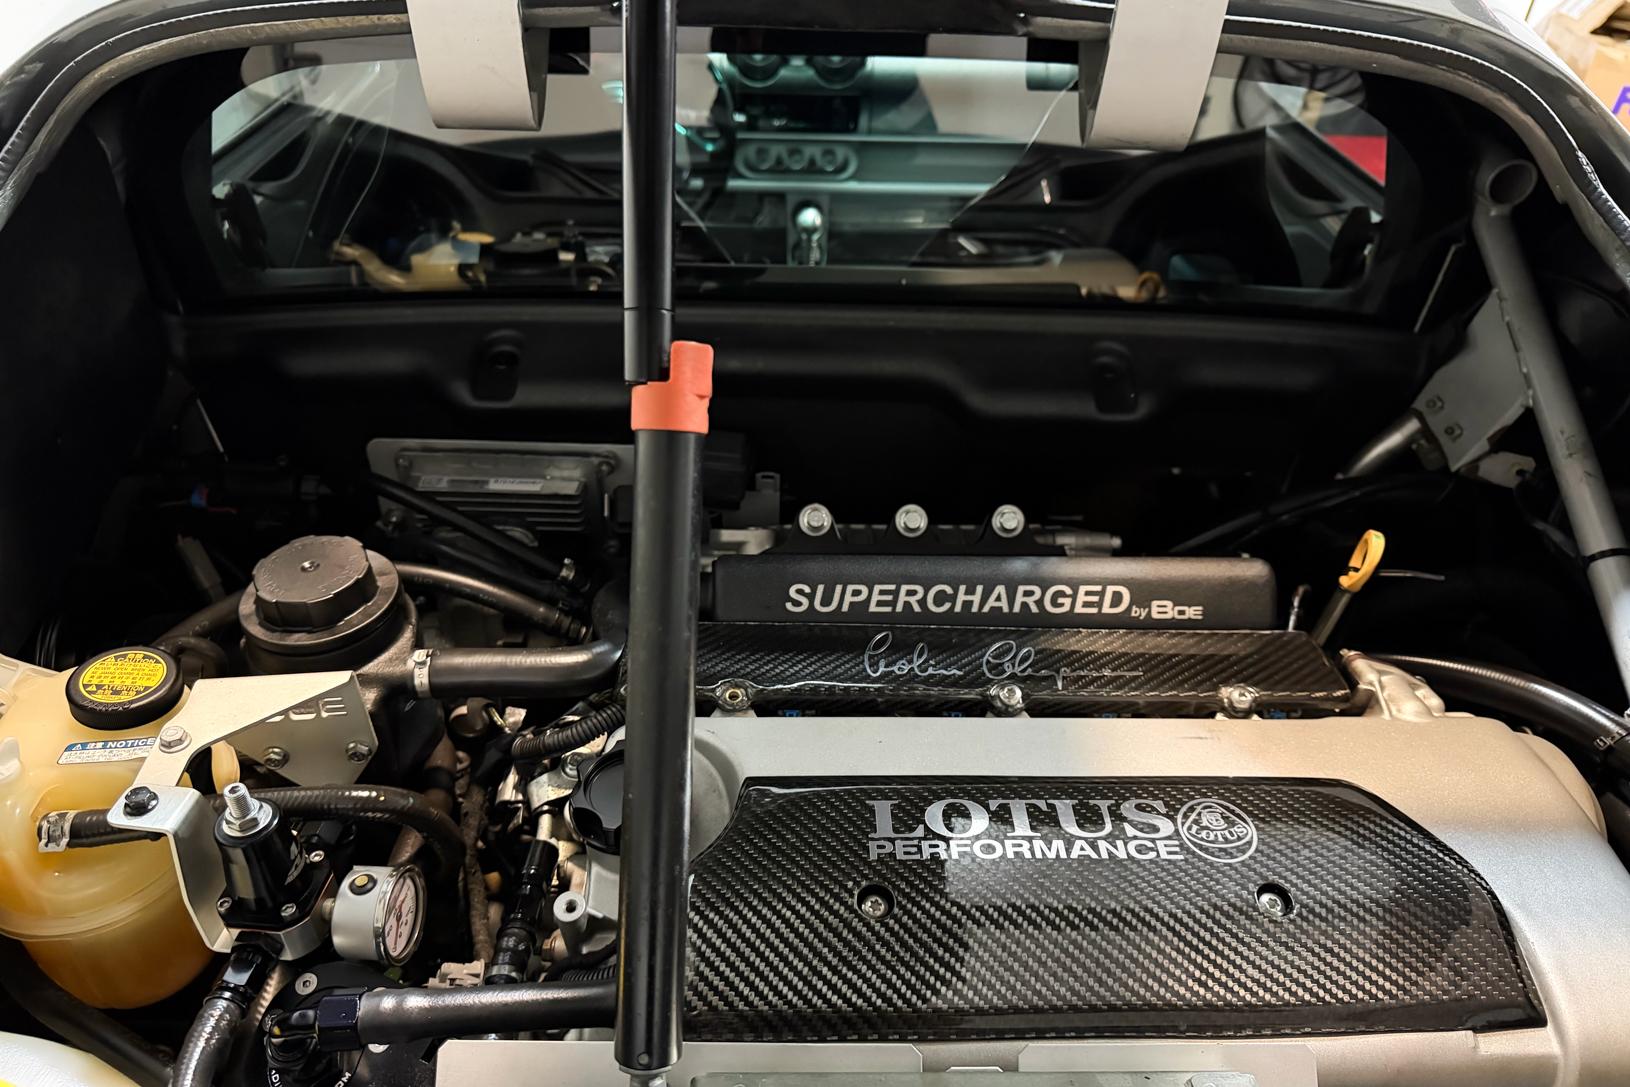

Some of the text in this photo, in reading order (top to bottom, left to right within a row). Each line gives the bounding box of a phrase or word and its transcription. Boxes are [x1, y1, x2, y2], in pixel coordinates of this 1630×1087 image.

[785, 584, 1131, 614] SUPERCHARGED
[1130, 605, 1149, 621] by
[107, 738, 156, 748] NOTICE
[869, 799, 1175, 838] LOTUS
[1189, 823, 1248, 842] LOTUS
[869, 839, 1185, 860] PERFORMANCE
